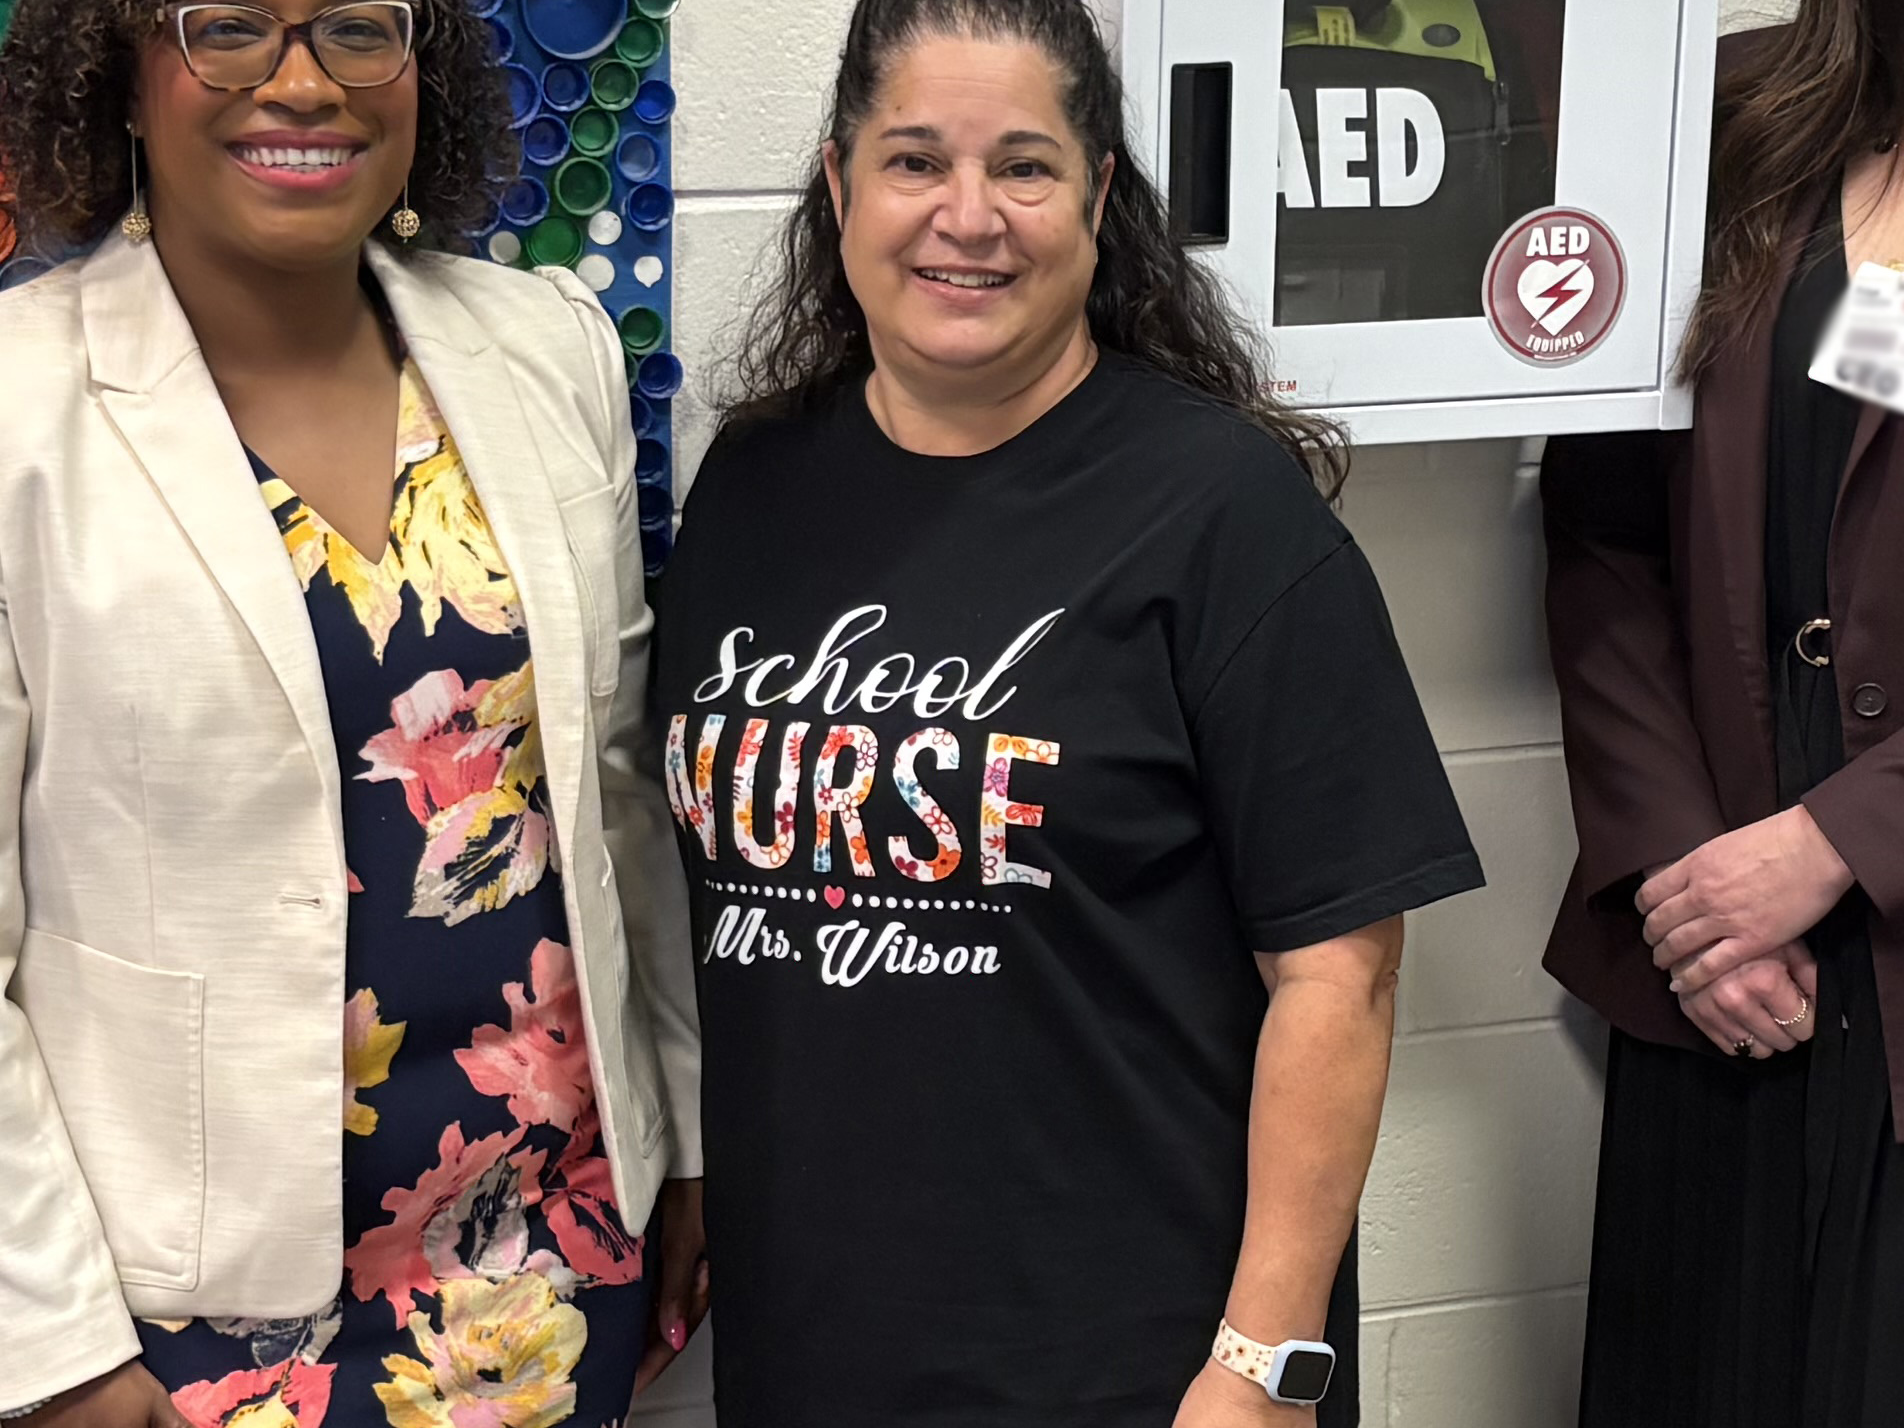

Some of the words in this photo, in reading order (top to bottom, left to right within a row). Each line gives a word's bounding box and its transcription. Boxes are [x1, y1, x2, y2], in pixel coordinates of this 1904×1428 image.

[1526, 226, 1590, 257] AED
[1526, 330, 1585, 353] EQUIPPED
[1258, 380, 1297, 392] STEM
[693, 603, 1066, 721] school
[665, 713, 1062, 890] NURSE
[704, 906, 802, 966] Mrs.
[816, 921, 1001, 988] Wilson
